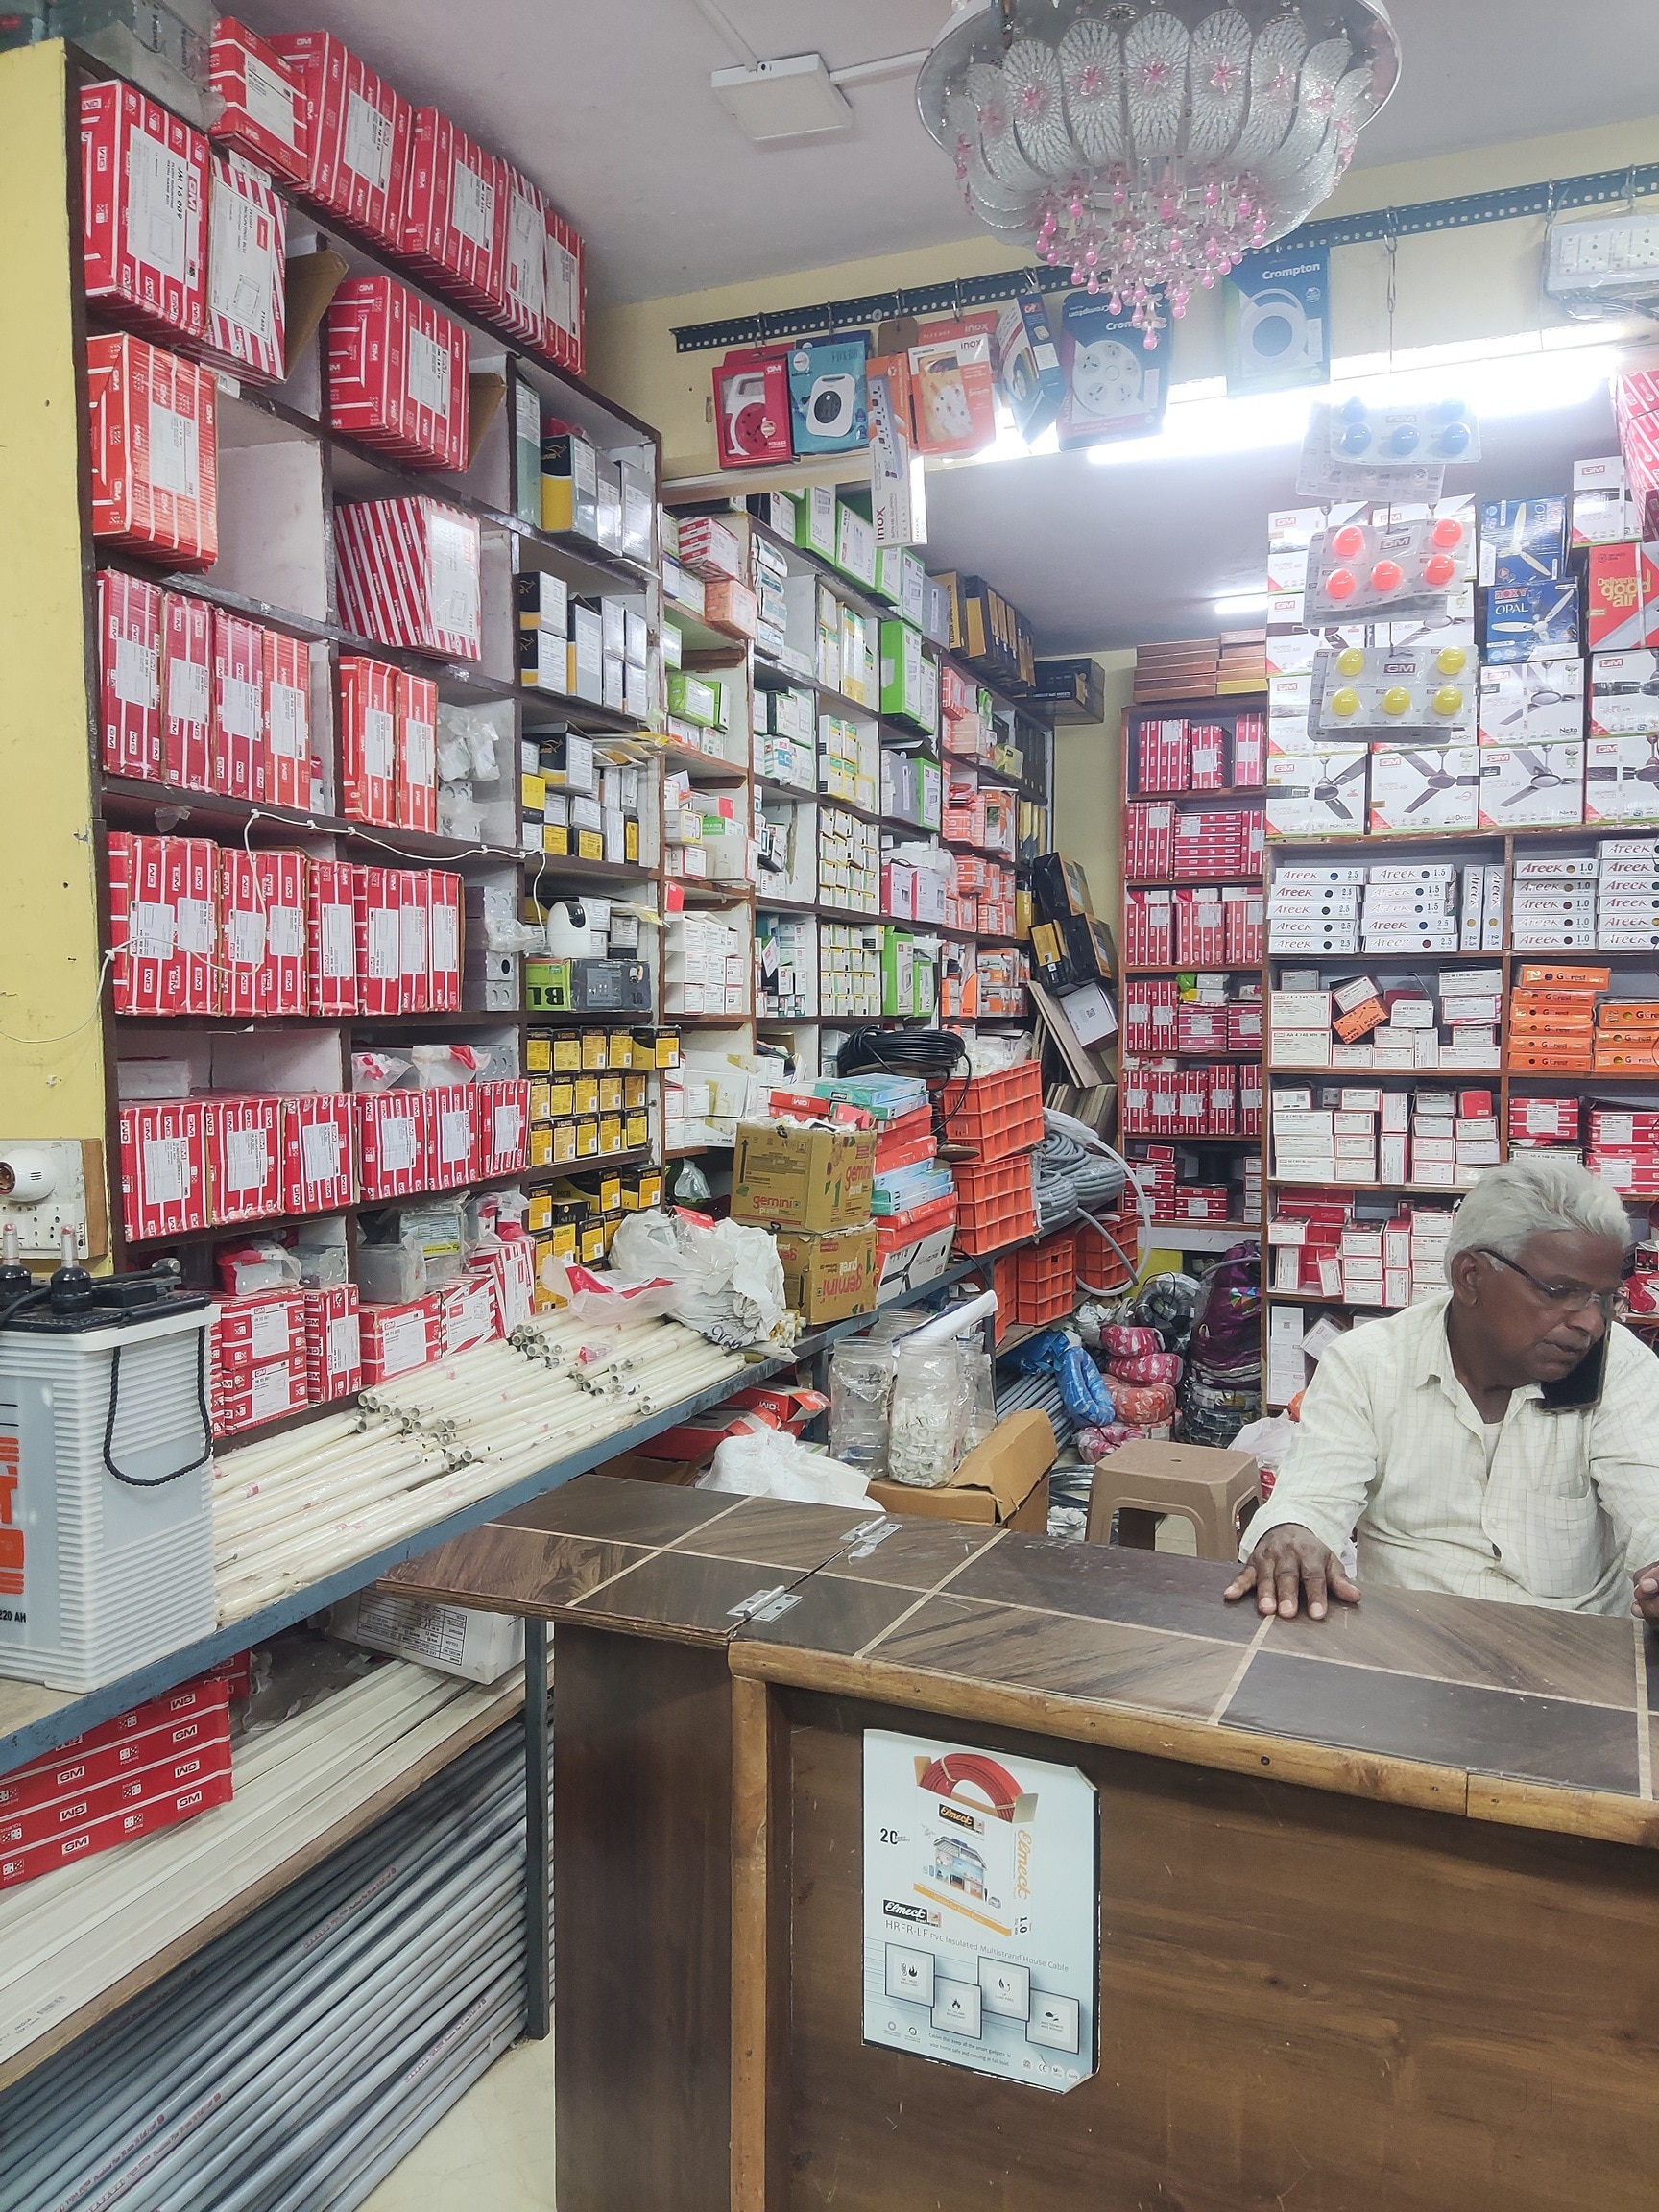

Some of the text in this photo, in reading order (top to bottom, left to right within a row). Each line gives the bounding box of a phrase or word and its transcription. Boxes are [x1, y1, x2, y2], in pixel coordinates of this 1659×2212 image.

[1262, 262, 1321, 280] Crompton
[964, 323, 989, 333] inox
[1583, 465, 1605, 474] GM
[876, 506, 886, 541] inox
[1276, 517, 1296, 526] GM
[1382, 537, 1410, 549] GM
[1598, 576, 1637, 586] Deliverin
[1601, 568, 1651, 601] good
[1494, 588, 1528, 600] ROXY
[1612, 593, 1637, 607] air
[1275, 601, 1295, 611] GM
[1495, 605, 1528, 615] OPAL
[1384, 663, 1415, 673] GM
[1600, 659, 1623, 667] GM
[1277, 683, 1298, 691] GM
[1609, 843, 1651, 854] Areek
[1521, 862, 1594, 873] Areek 1.0
[1607, 862, 1651, 872] Areek
[1283, 868, 1358, 879] Areek 2.5
[1379, 868, 1446, 878] Areek 1.5
[1429, 885, 1440, 894] 1.5
[1577, 881, 1590, 891] 1.0
[1604, 880, 1648, 891] Areek
[1276, 887, 1313, 897] Areek
[1427, 902, 1438, 911] 1.5
[1519, 899, 1590, 909] Areek 1.0
[1605, 898, 1648, 908] Areek
[1274, 904, 1310, 914] Areek
[1276, 922, 1313, 931] Areek
[1369, 920, 1407, 930] Areek
[1604, 917, 1649, 926] Areek
[1275, 939, 1311, 949] Areek
[1440, 937, 1452, 946] 2.5
[1519, 934, 1590, 945] Areek 1.0
[753, 1195, 795, 1210] gemini
[822, 1263, 864, 1296] gemini
[14, 1611, 27, 1623] AH
[172, 1695, 195, 1709] GM
[175, 1726, 196, 1740] GM
[60, 1767, 84, 1782] GM
[177, 1762, 198, 1776] GM
[179, 1793, 201, 1807] GM
[61, 1805, 85, 1820] GM
[941, 1805, 974, 1826] Elmeck
[879, 1828, 899, 1845] 20
[65, 1838, 88, 1853] GM
[1018, 1829, 1033, 1900] Elmeck
[884, 1901, 927, 1919] Elmeck
[1020, 1916, 1028, 1934] 1.0
[885, 1919, 1070, 1972] HRFR-LF PVC Insulated Multistrand House Cable
